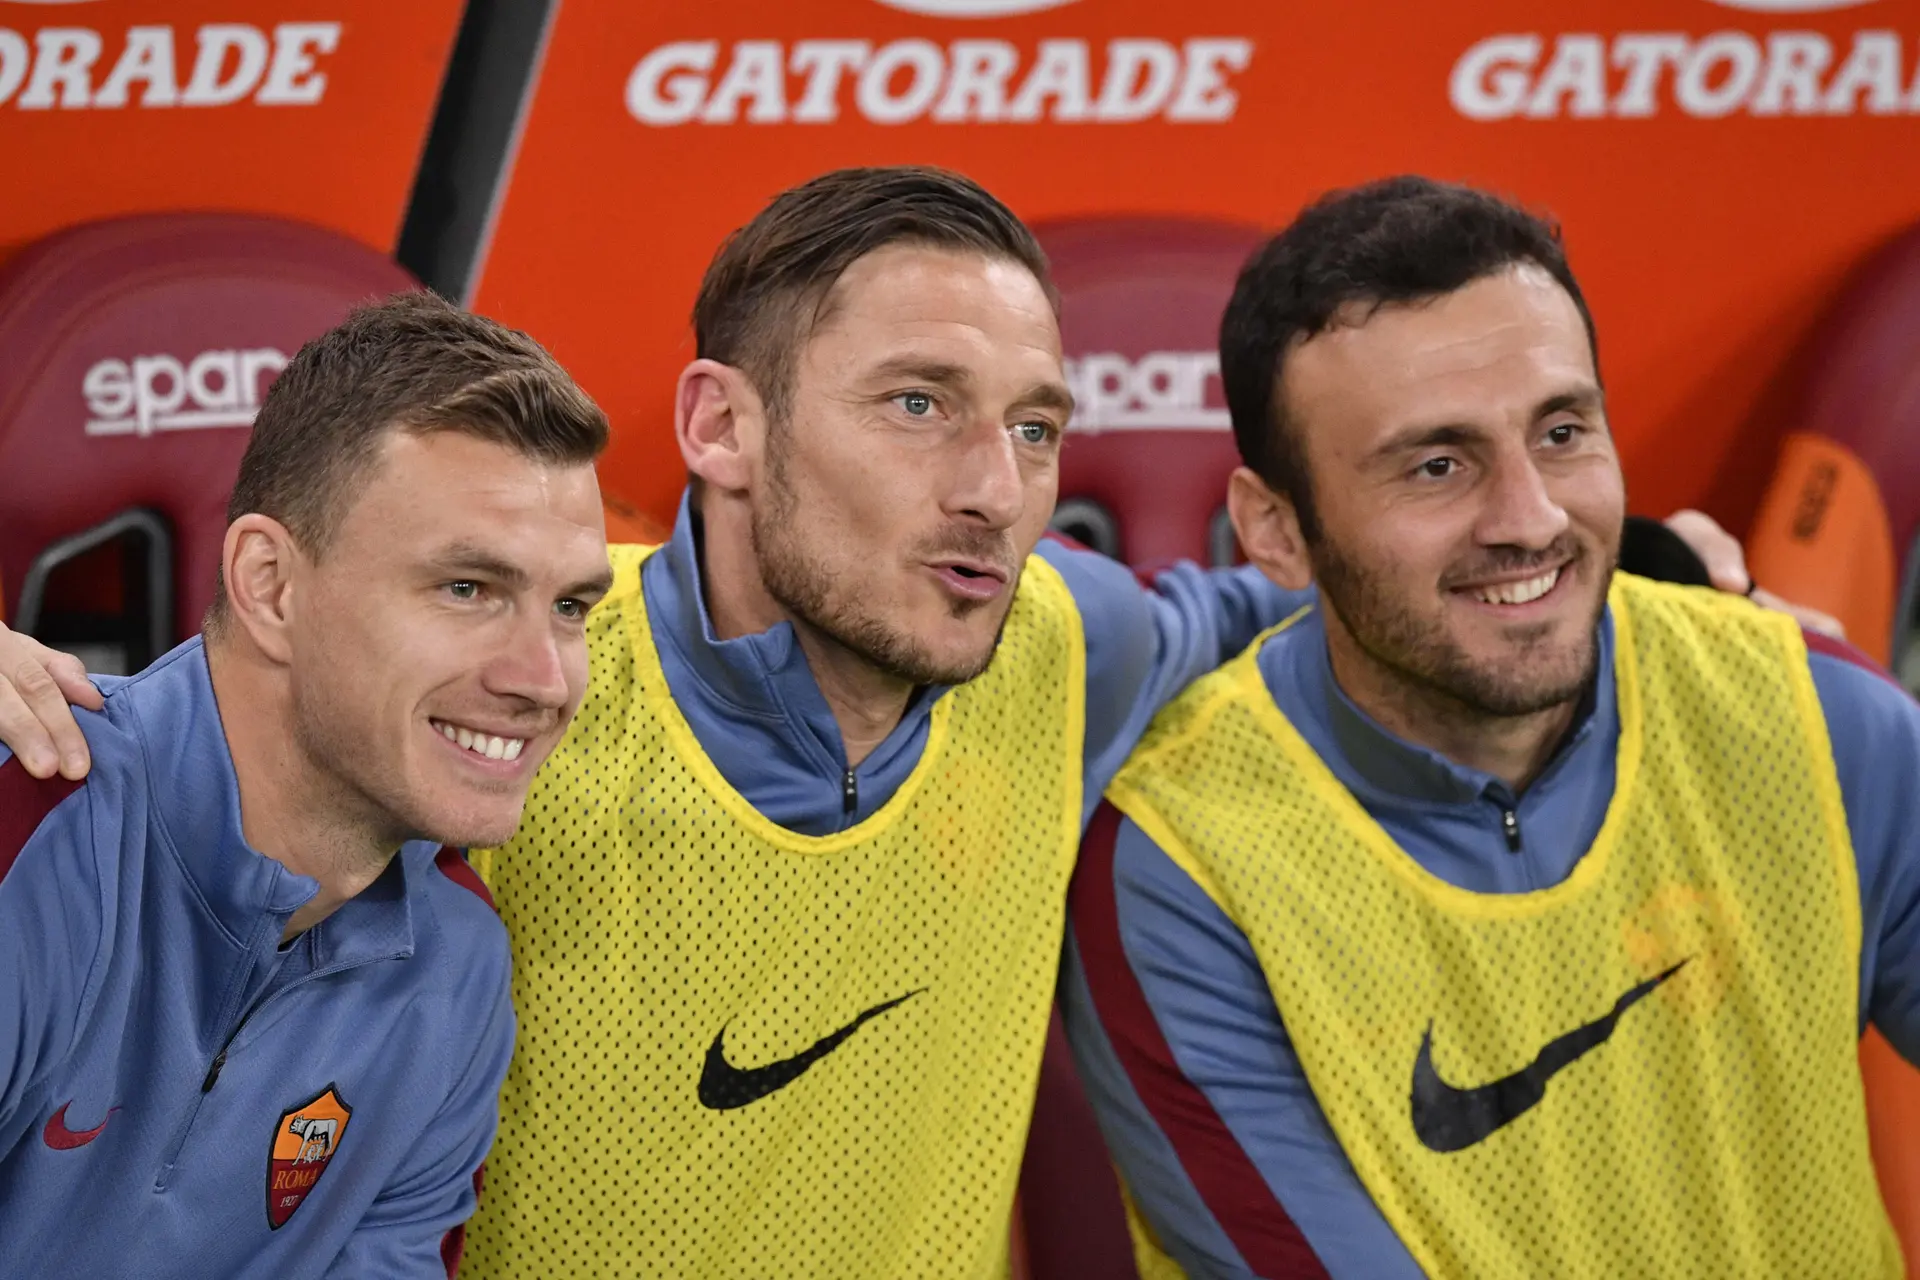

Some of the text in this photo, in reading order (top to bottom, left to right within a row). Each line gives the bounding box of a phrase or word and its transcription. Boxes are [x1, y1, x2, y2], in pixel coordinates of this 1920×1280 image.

[625, 38, 1253, 126] GATORADE
[1449, 33, 1920, 121] GATORA
[273, 1168, 318, 1190] ROMA
[280, 1194, 299, 1208] 1927
